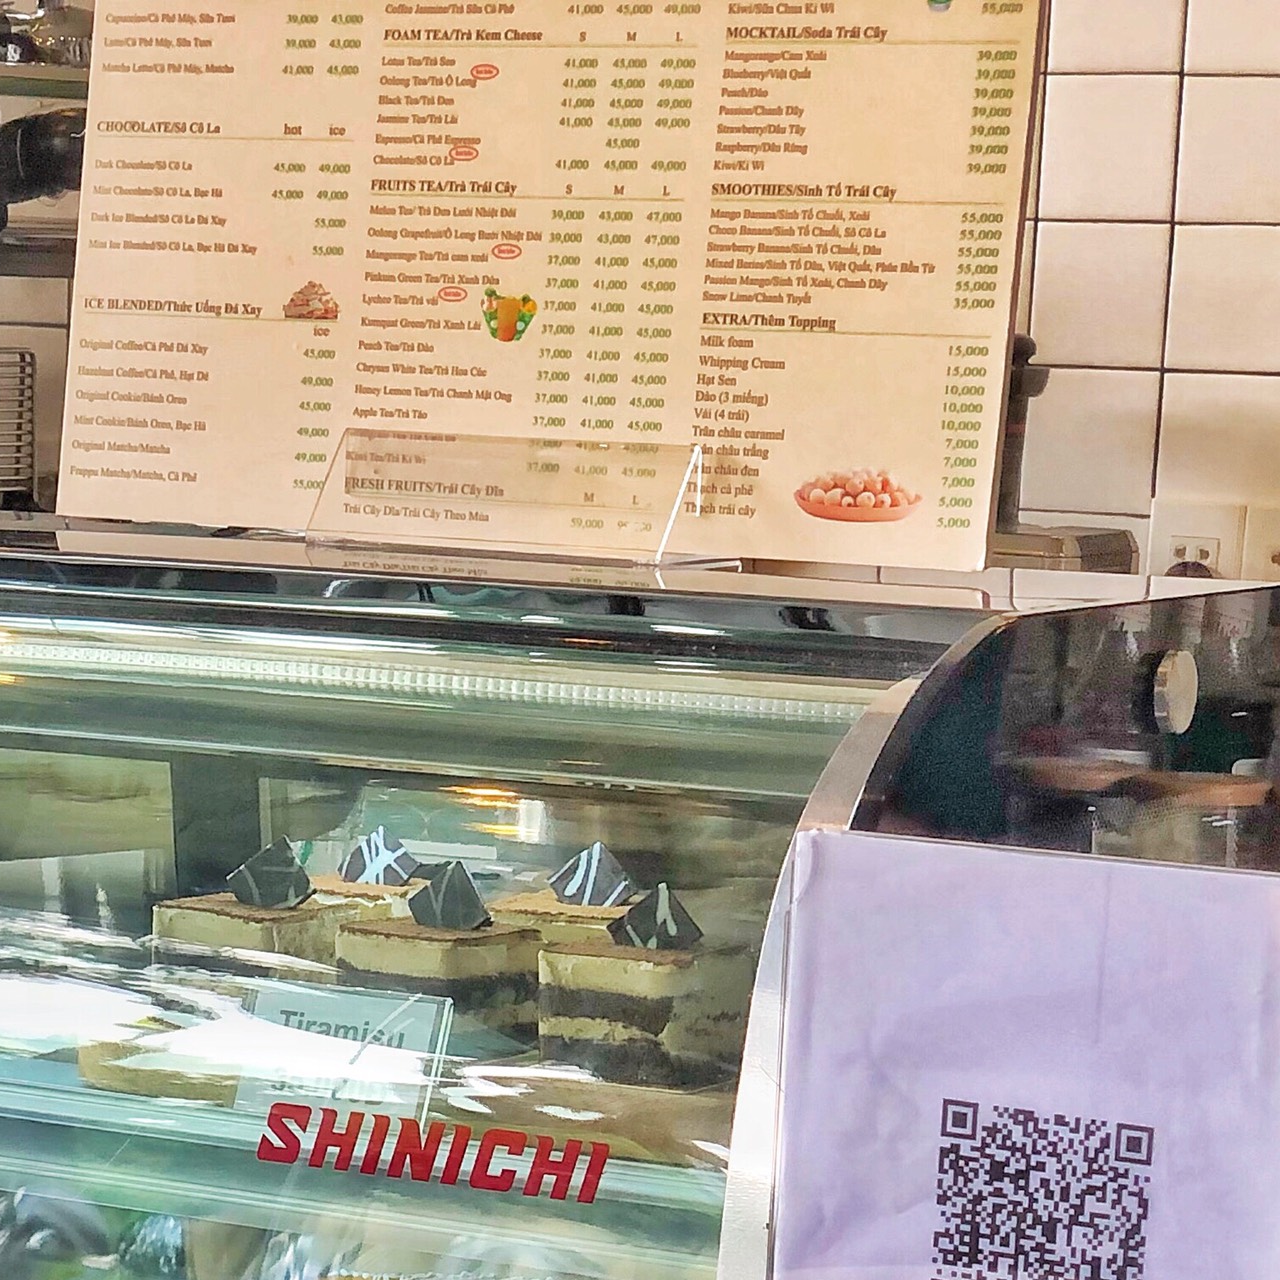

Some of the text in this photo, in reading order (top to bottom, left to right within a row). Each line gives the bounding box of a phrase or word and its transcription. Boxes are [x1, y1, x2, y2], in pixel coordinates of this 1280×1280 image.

[982, 3, 1023, 15] 55,000
[384, 29, 683, 42] FOAM TEA/Trà Kem Cheese S M L
[726, 26, 889, 44] MOCKTAIL/Soda Trái Cây
[977, 50, 1017, 61] 39,000
[282, 65, 359, 77] 41,000 45,000
[975, 69, 1015, 81] 39,000
[975, 88, 1014, 100] 39,000
[972, 106, 1012, 118] 39,000
[207, 123, 220, 133] La
[284, 123, 302, 135] hot
[329, 124, 346, 136] ice
[970, 125, 1010, 137] 39,000
[968, 144, 1008, 155] 39,000
[273, 163, 351, 174] 45,000 49,000
[967, 163, 1006, 175] 39,000
[371, 179, 670, 198] FRUITS TEA/Trà Trái Cây S M L
[712, 183, 822, 196] SMOOTHIES/Sinh
[845, 185, 870, 197] Trái
[873, 186, 898, 203] Cây
[272, 190, 348, 201] 45,000 49,000
[552, 210, 682, 223] 39,000 43,000 47,000
[961, 212, 1003, 223] 55,000
[315, 218, 346, 228] 55,000
[959, 229, 1002, 241] 55,000
[313, 246, 344, 256] 55,000
[958, 247, 999, 258] 55,000
[957, 264, 998, 276] 55,000
[955, 281, 996, 292] 55,000
[85, 298, 104, 309] ICE
[241, 304, 264, 320] Xay
[954, 298, 995, 309] 35,000
[701, 313, 839, 333] EXTRA/Thêm Topping
[313, 326, 330, 336] ice
[700, 335, 989, 357] Milk foam 15,000
[303, 349, 335, 360] 45,000
[699, 355, 987, 377] Whipping Cream 15,000
[301, 376, 333, 387] 49,000
[697, 373, 985, 396] Hạt Sen 10,000
[299, 401, 331, 411] 45,000
[696, 389, 983, 413] Đào (3 miếng) 10,000
[533, 416, 662, 432] 37,000 41,000 45,000
[715, 409, 725, 421] (4
[728, 409, 749, 423] trái)
[942, 420, 981, 432] 10,000
[297, 427, 329, 437] 49,000
[692, 425, 979, 450] Trân châu caramel 7,000
[295, 452, 326, 462] 49,000
[716, 445, 739, 458] châu
[944, 457, 977, 468] 7,000
[714, 463, 738, 475] châu
[741, 465, 759, 477] đen
[942, 477, 975, 488] 7,000
[293, 478, 326, 492] 55,000
[345, 477, 384, 492] FRESH
[461, 484, 482, 498] Cây
[584, 492, 594, 502] M
[633, 495, 639, 505] L
[734, 484, 755, 498] phê
[939, 496, 972, 507] 5,000
[444, 509, 466, 520] Theo
[571, 518, 604, 529] 59,000
[719, 504, 735, 515] trái
[738, 505, 756, 518] cây
[937, 517, 970, 528] 5,000
[256, 1102, 610, 1203] SHINICHI
